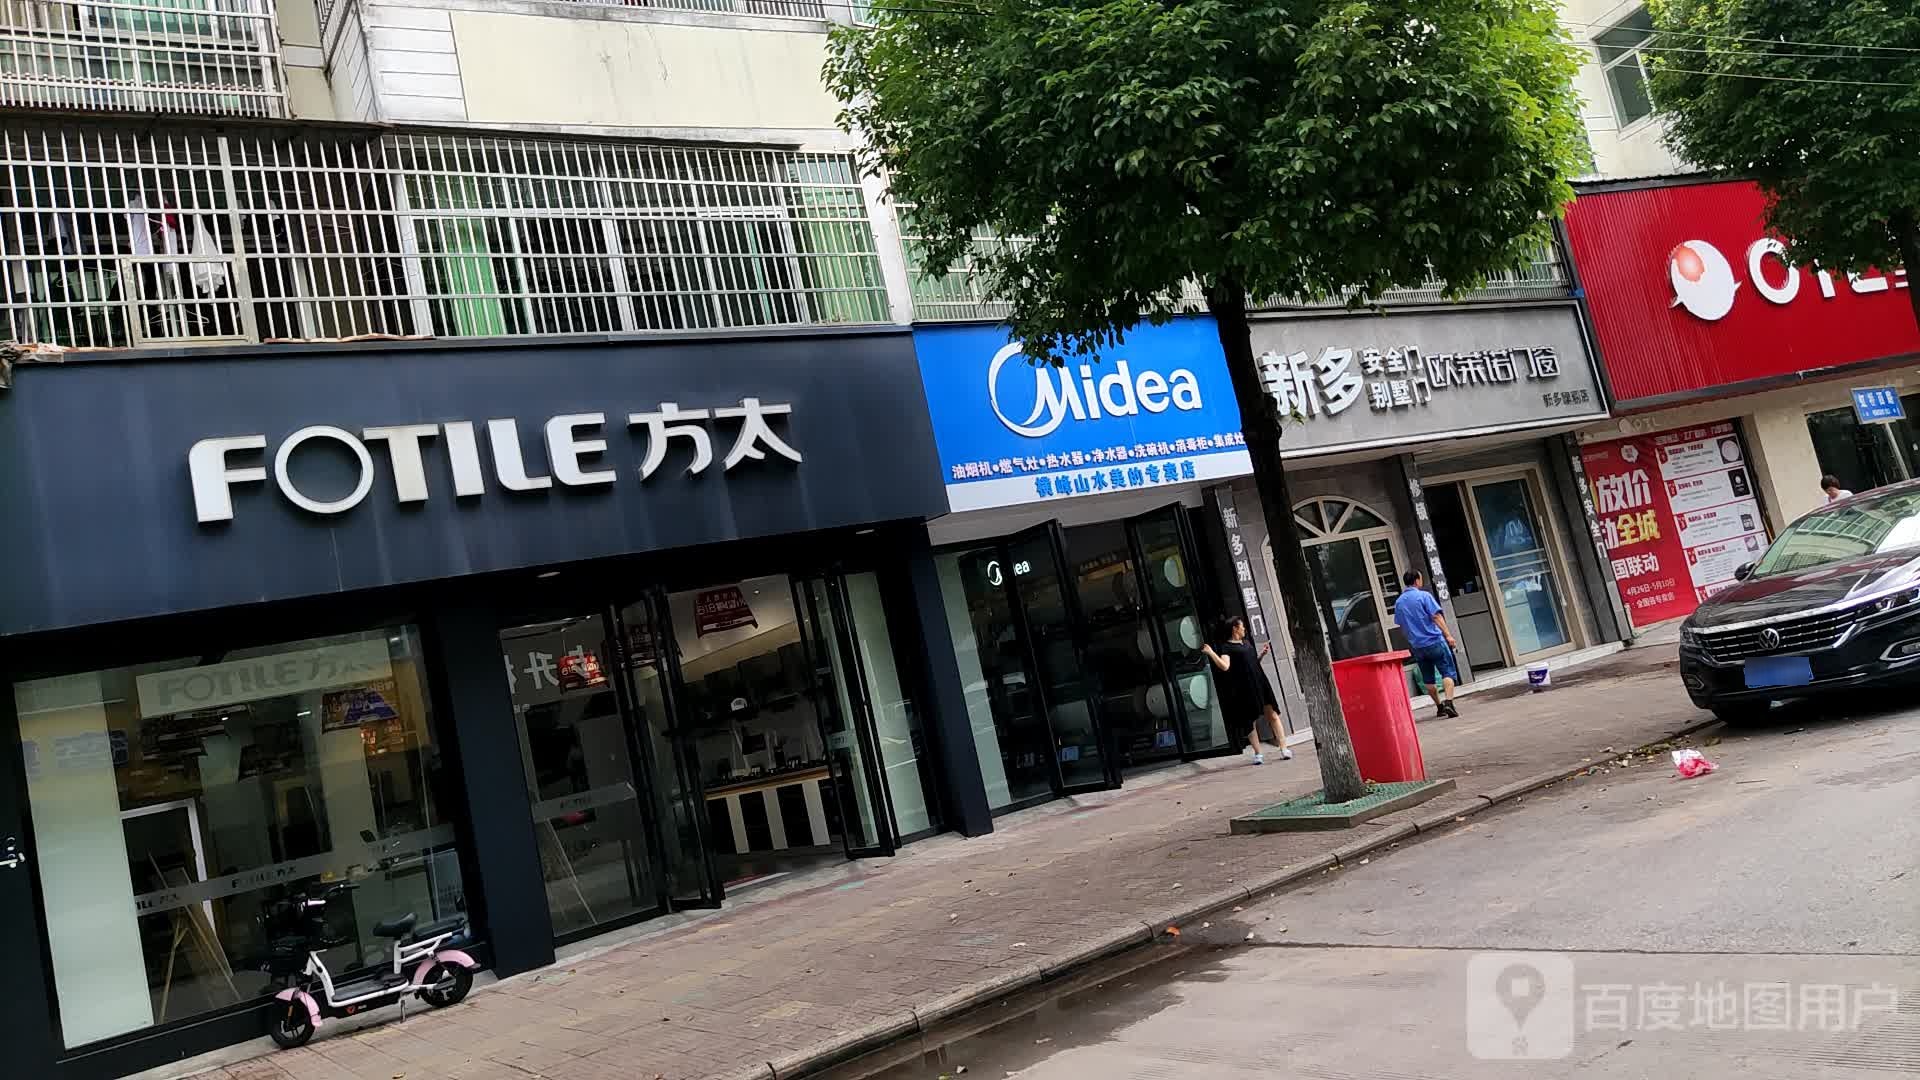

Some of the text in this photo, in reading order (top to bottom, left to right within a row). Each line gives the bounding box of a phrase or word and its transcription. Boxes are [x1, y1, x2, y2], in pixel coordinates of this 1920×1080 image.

[988, 342, 1203, 438] Midea
[1257, 345, 1364, 418] 新多
[1359, 345, 1424, 375] 安全门
[1365, 376, 1432, 411] 别墅门
[1425, 346, 1562, 389] 欧莱诺门窗
[188, 397, 803, 523] FOTILE 方太
[1035, 459, 1197, 499] 横峰山水美的专卖店
[1571, 455, 1608, 559] 新多安全门
[1222, 507, 1266, 637] 新多别墅门
